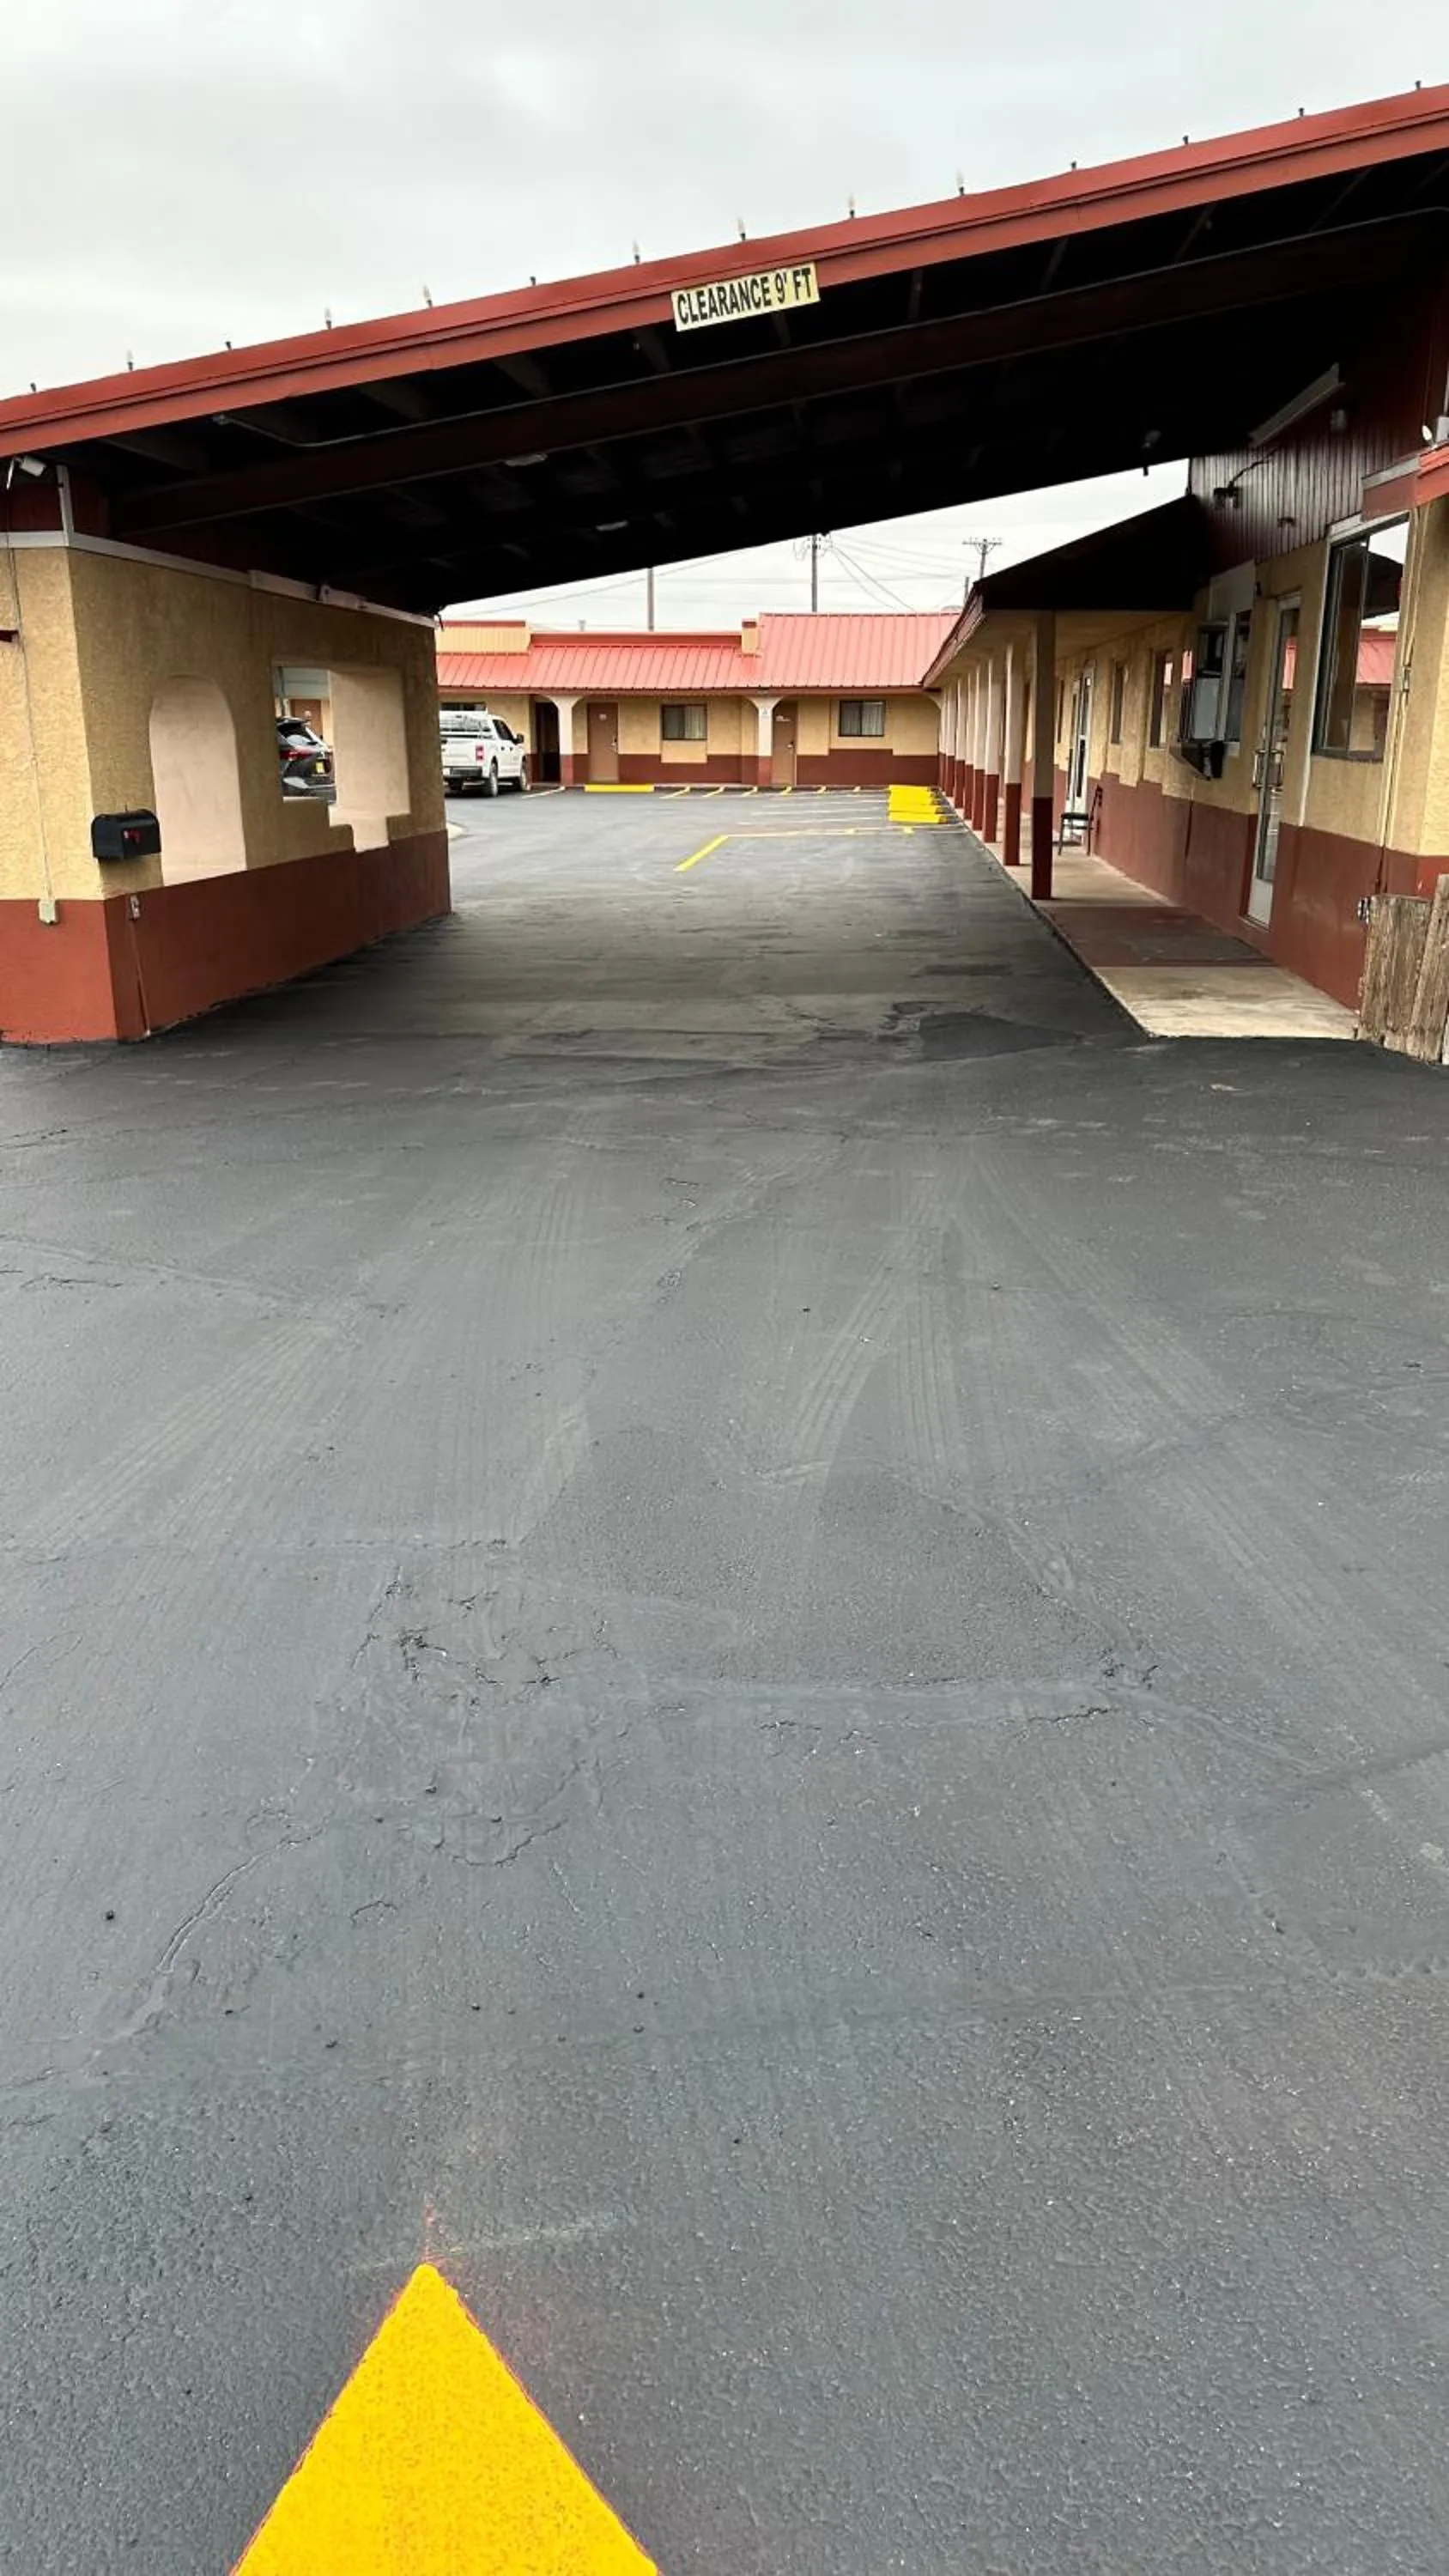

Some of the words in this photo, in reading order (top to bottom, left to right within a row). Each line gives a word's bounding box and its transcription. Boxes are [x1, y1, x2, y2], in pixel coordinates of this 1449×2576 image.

[677, 276, 772, 325] CLEARANCE
[774, 270, 787, 303] 9'
[792, 267, 811, 301] FT
